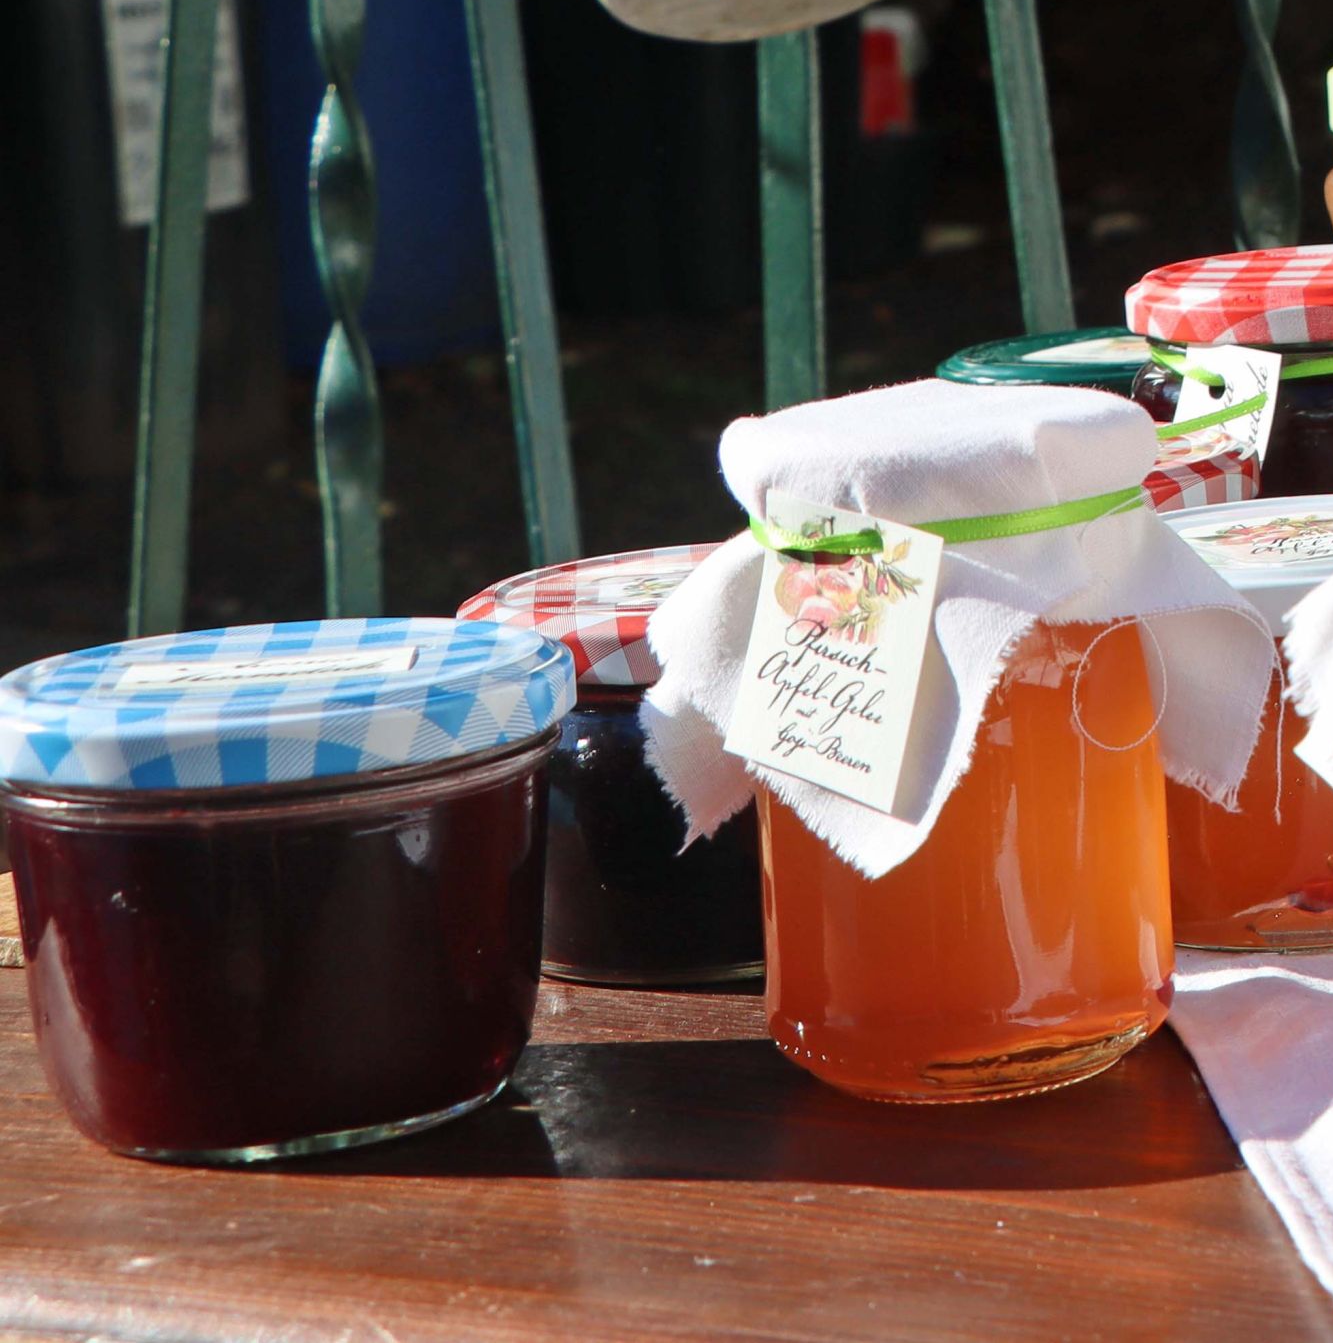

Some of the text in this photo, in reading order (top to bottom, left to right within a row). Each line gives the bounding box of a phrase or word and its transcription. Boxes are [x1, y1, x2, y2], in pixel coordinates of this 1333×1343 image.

[785, 618, 888, 675] Pfirsich-
[757, 650, 886, 735] Apfel-Gelee
[771, 722, 873, 774] Goji-Beeren
